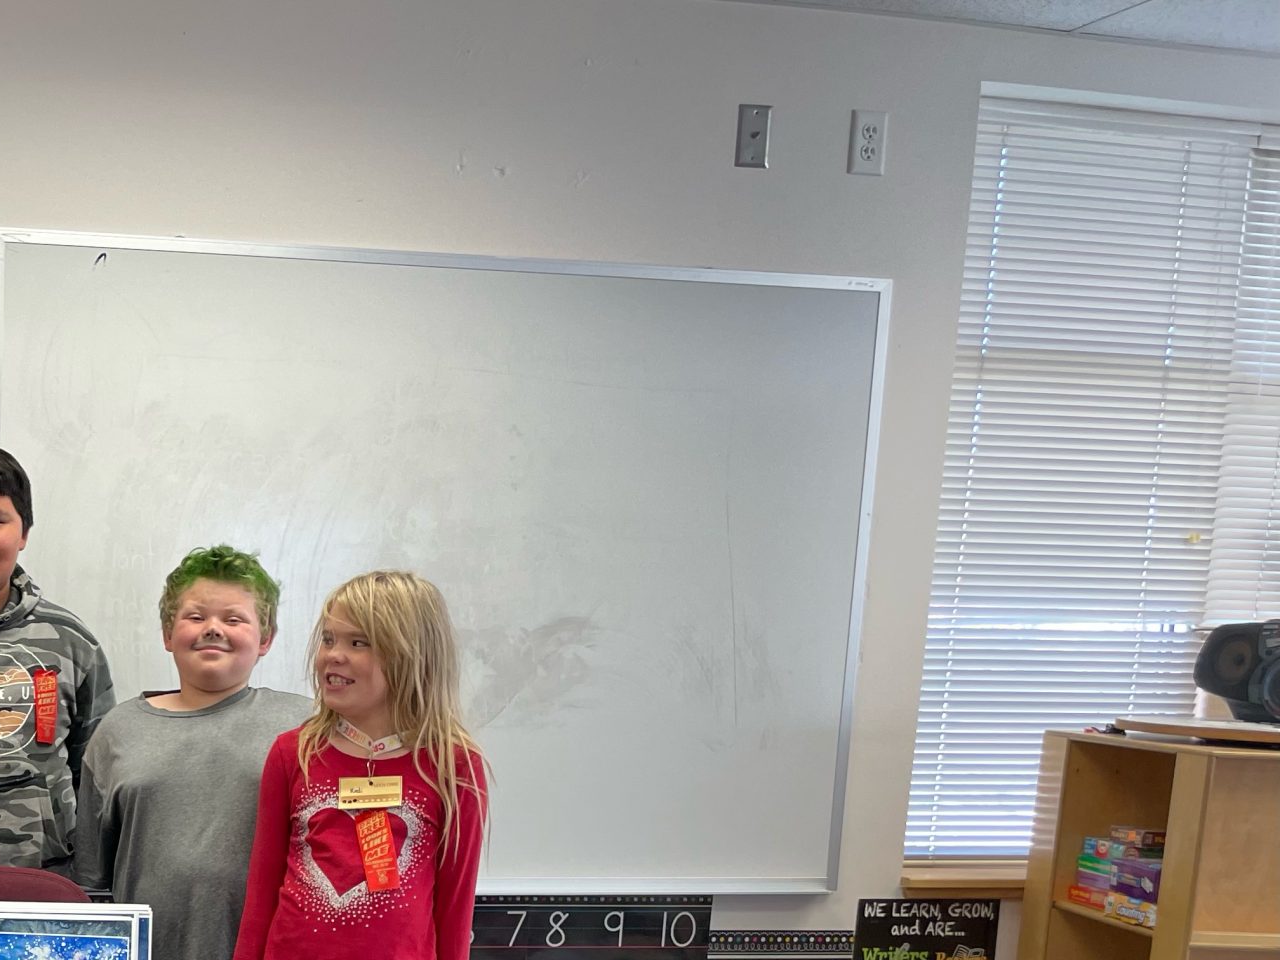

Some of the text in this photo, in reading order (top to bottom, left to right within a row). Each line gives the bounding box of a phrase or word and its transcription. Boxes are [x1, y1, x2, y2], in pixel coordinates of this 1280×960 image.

[360, 820, 385, 837] FREE
[363, 836, 388, 850] LIKE
[365, 845, 390, 862] ME
[864, 902, 994, 919] WE LEARN, GROW,
[507, 911, 696, 947] 7 8 9 10
[891, 921, 920, 936] and
